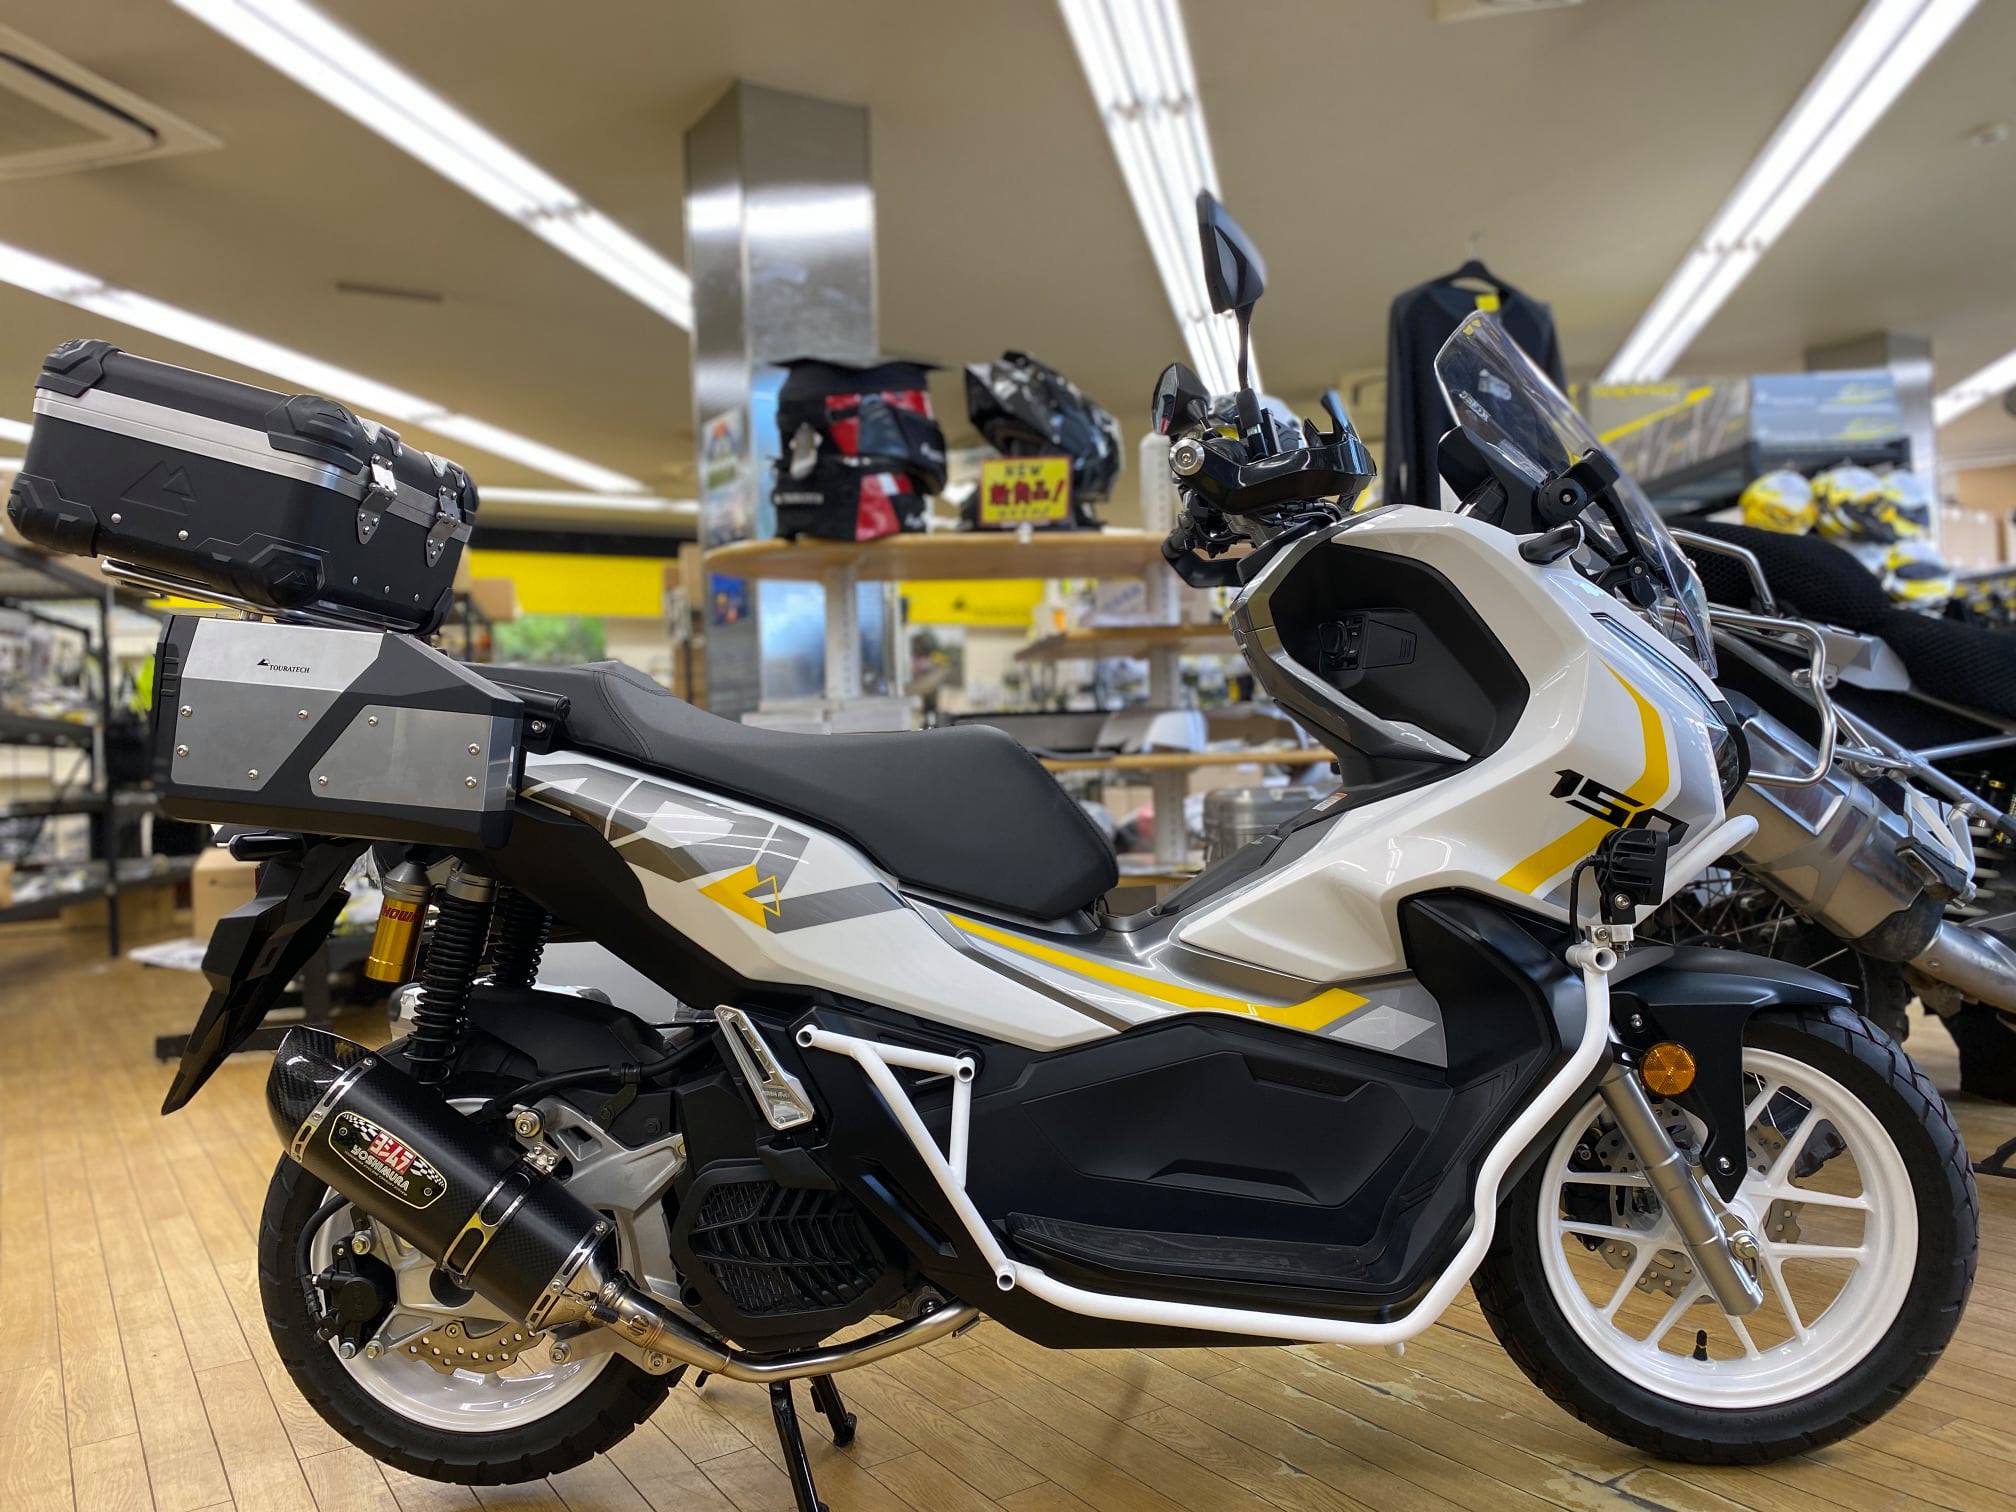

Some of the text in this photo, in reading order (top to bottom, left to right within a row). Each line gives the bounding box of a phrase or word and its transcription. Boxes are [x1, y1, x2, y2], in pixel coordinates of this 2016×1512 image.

[269, 664, 310, 674] TOURATECH
[1550, 769, 1690, 847] 150
[350, 1144, 411, 1192] YOSHIMURA
